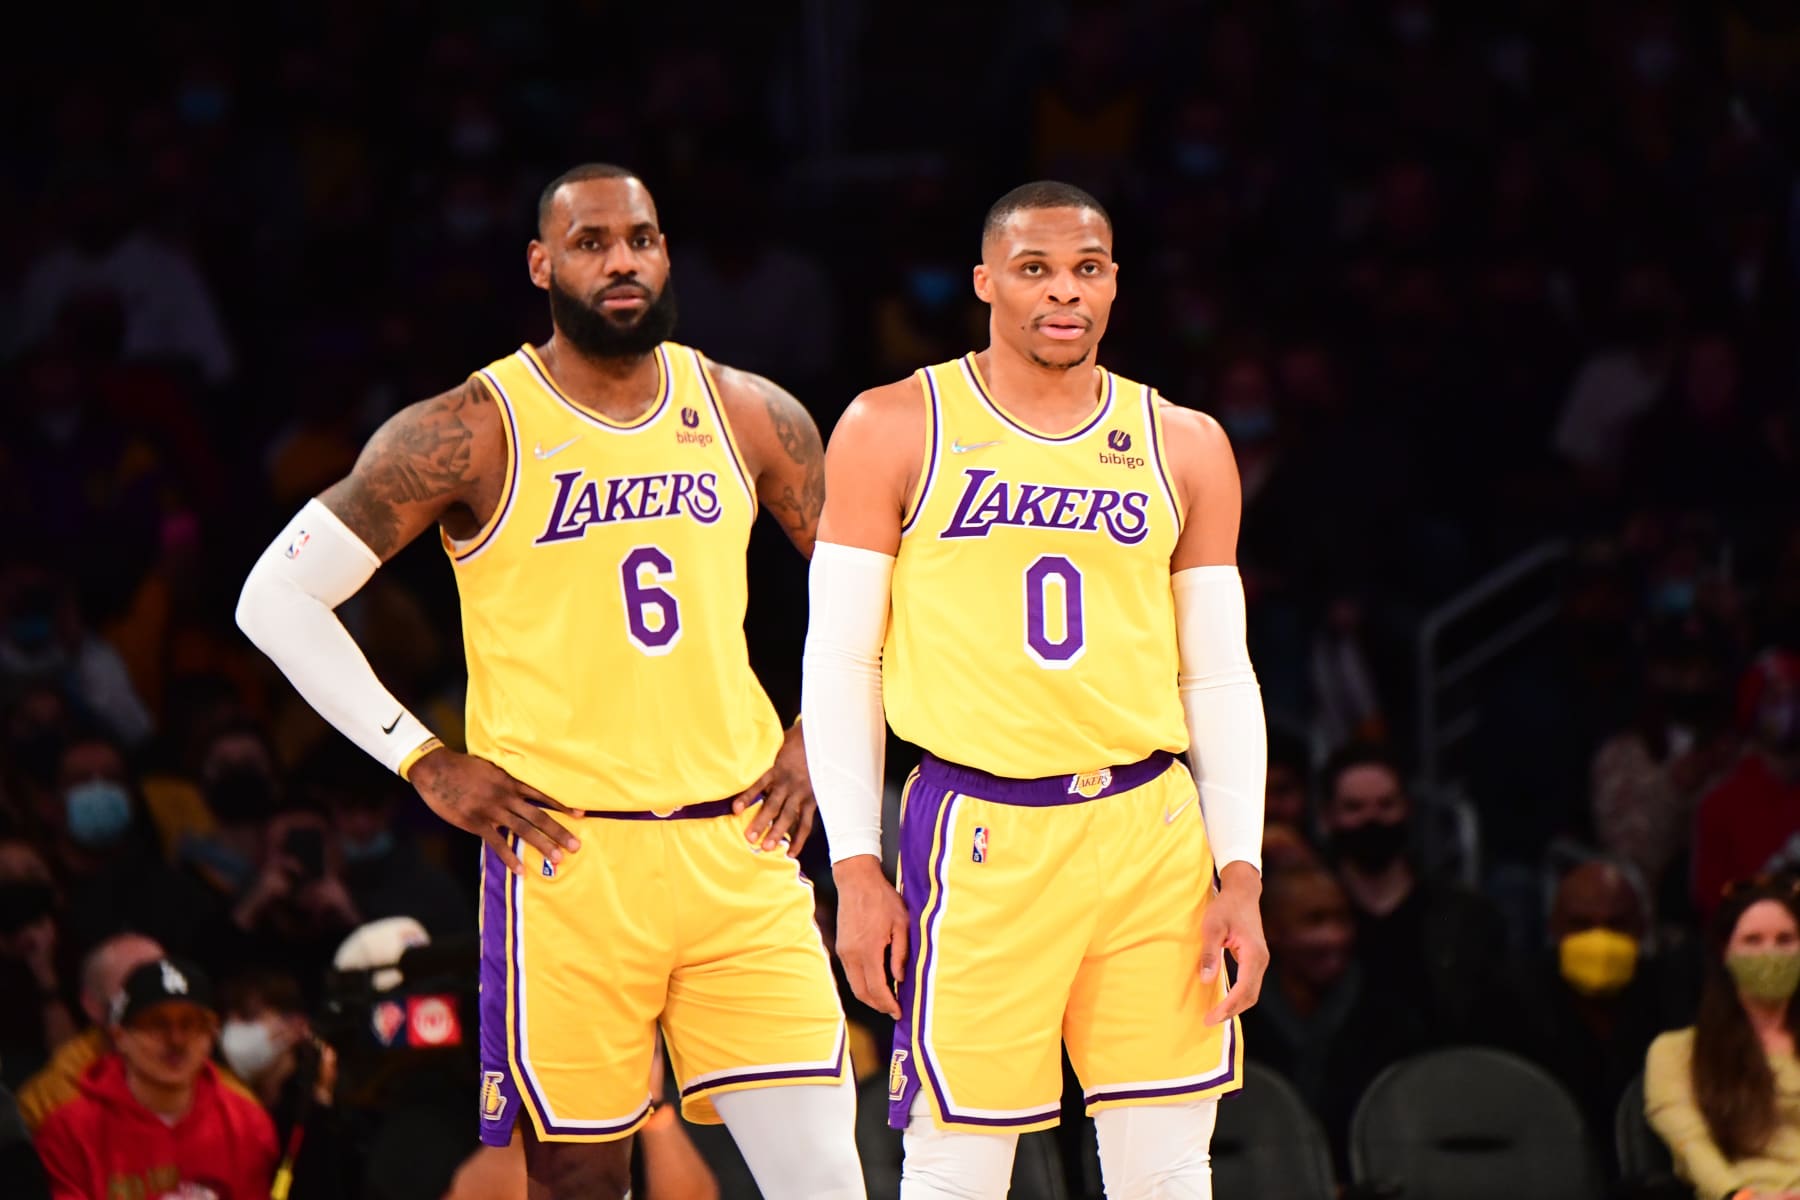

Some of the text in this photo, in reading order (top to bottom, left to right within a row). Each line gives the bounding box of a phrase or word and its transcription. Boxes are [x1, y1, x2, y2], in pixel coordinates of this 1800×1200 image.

[676, 431, 714, 448] bibigo
[1099, 452, 1146, 469] bibigo
[534, 470, 723, 544] LAKERS
[939, 469, 1149, 545] LAKERS
[621, 546, 681, 648] 6
[1025, 555, 1084, 661] 0
